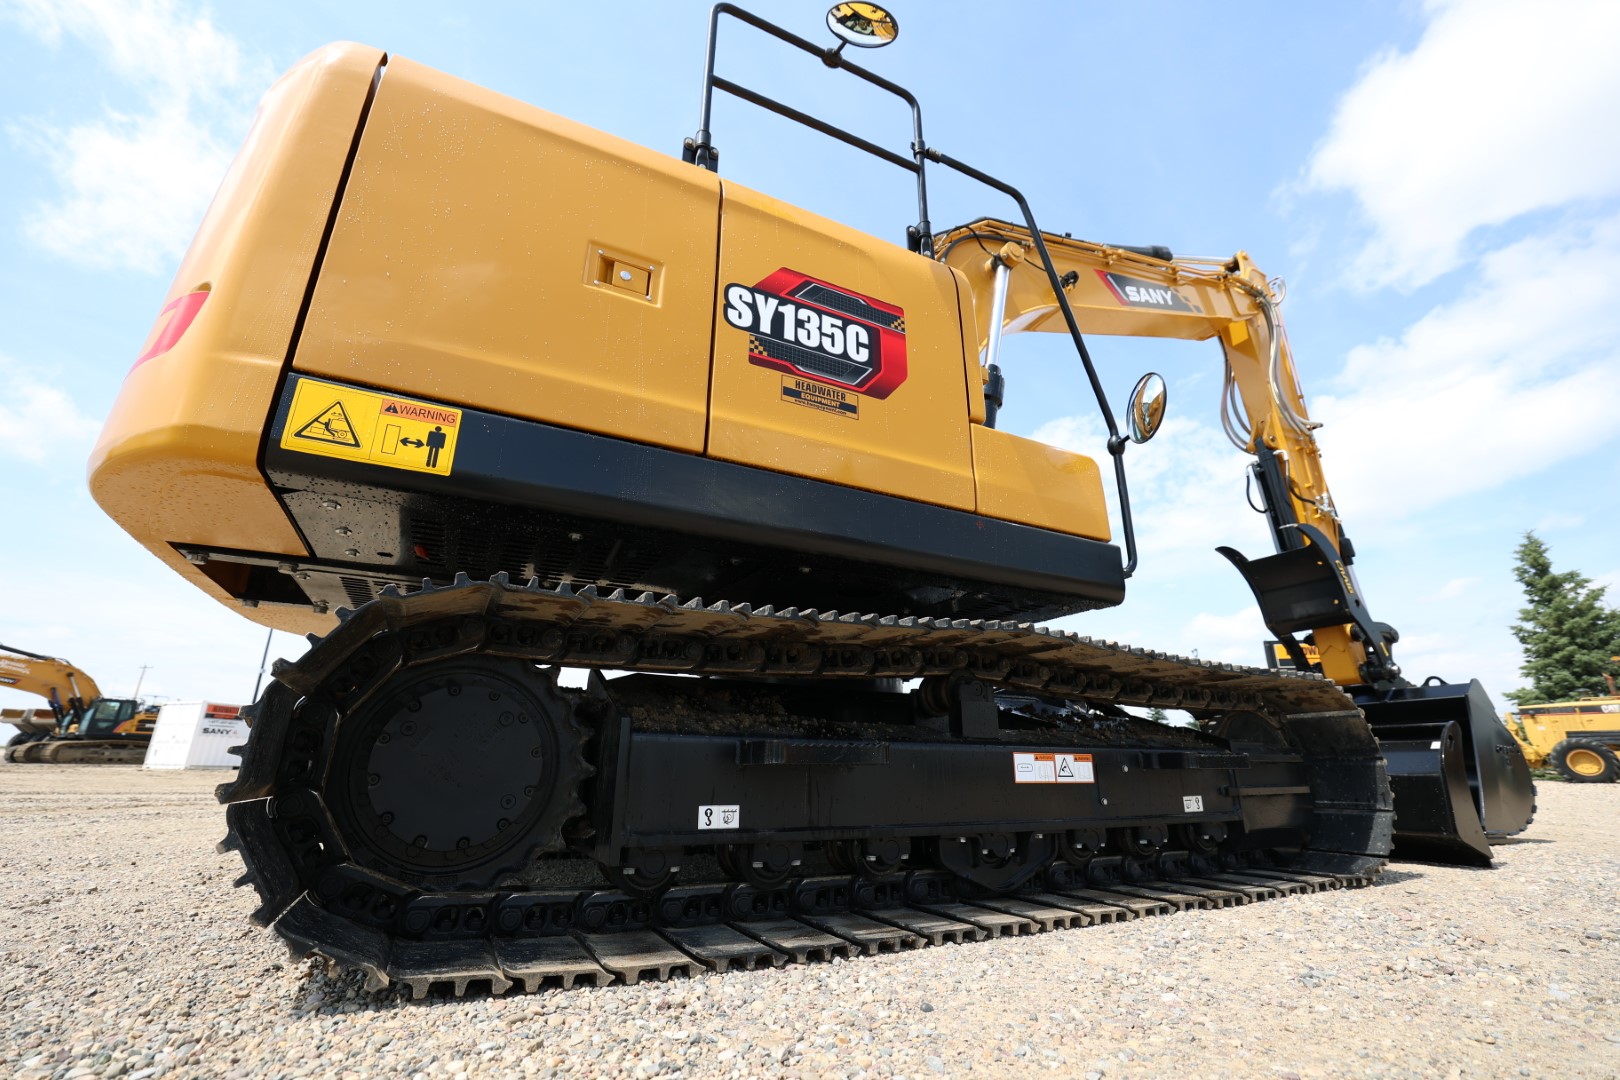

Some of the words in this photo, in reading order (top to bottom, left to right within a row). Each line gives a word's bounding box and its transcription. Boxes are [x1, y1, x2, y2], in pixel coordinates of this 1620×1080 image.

[1125, 286, 1173, 305] SANY
[727, 286, 869, 363] SY135C
[795, 380, 846, 401] HEADWATER
[801, 392, 840, 408] EQUIPMENT
[400, 405, 456, 423] WARNING
